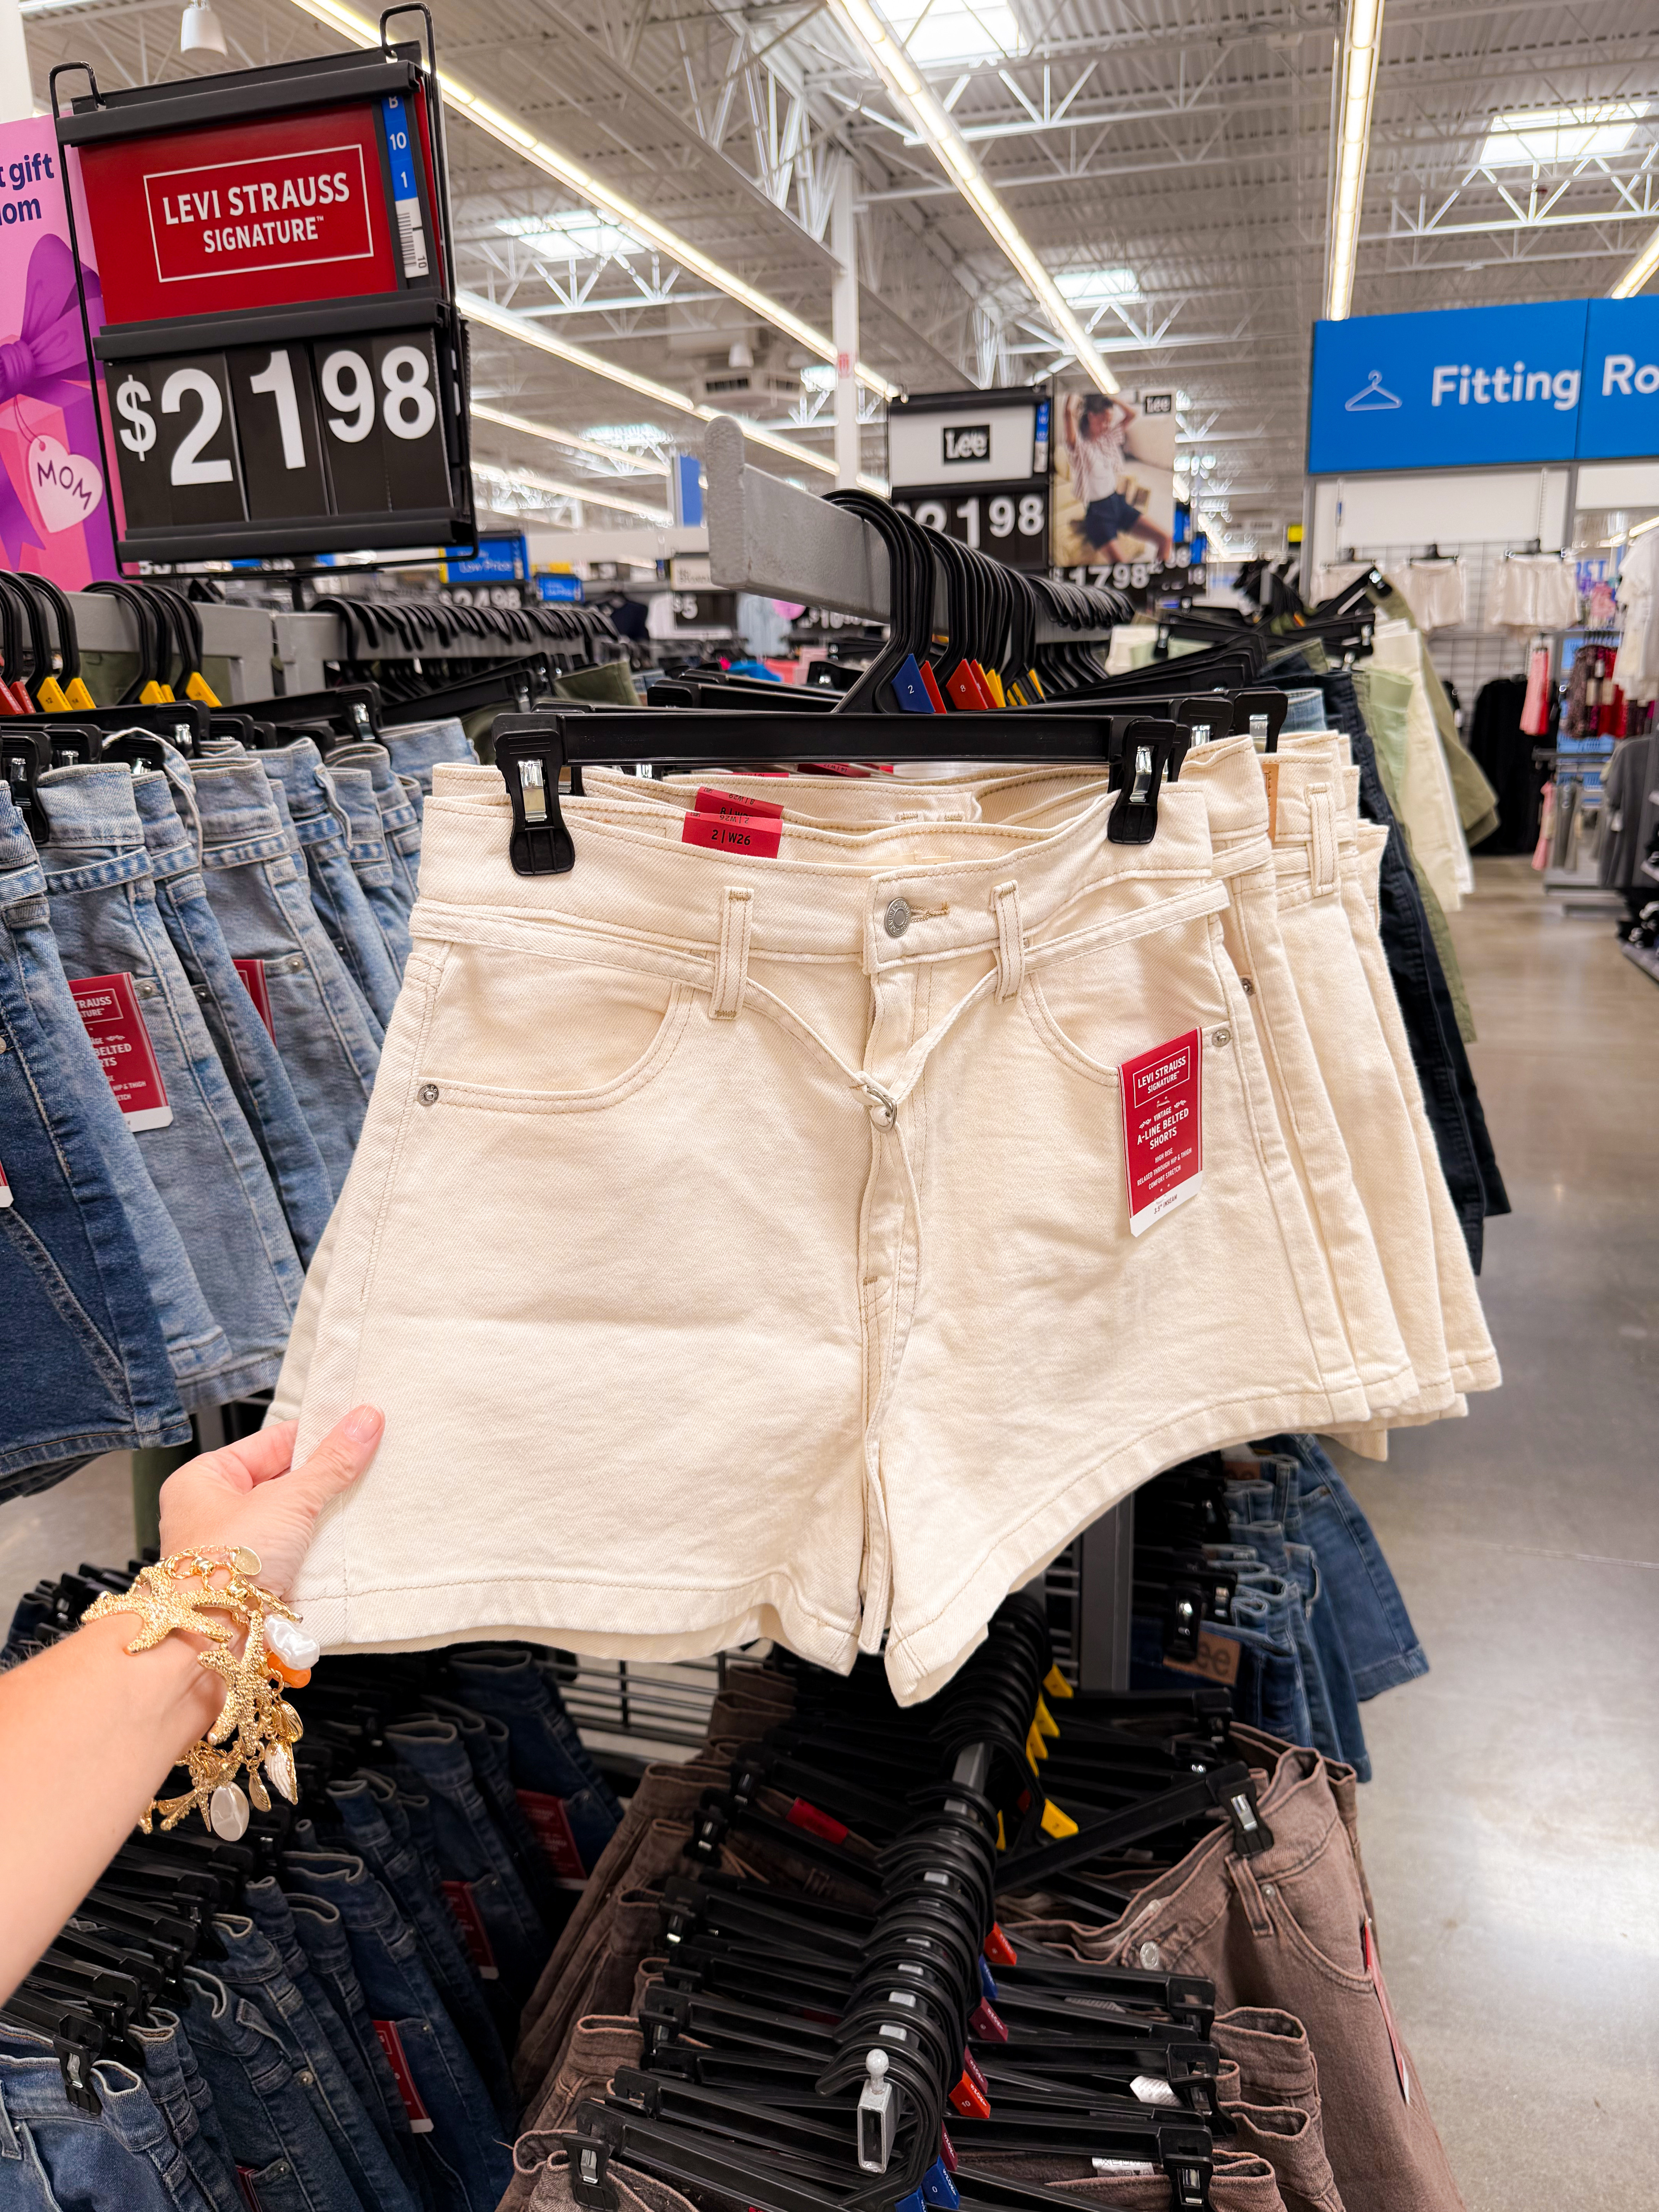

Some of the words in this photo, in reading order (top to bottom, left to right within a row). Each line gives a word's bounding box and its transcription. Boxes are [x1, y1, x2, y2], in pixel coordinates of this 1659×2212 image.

[390, 132, 407, 151] 10
[9, 153, 54, 191] gift
[401, 171, 408, 188] 1
[162, 189, 220, 225] LEVI
[229, 172, 349, 217] STRAUSS
[0, 198, 41, 225] om
[417, 255, 427, 269] 10
[1431, 360, 1581, 410] Fitting
[1602, 354, 1659, 396] Ro
[1146, 397, 1170, 413] Lee
[945, 430, 987, 459] Lee
[37, 460, 91, 510] MOM
[908, 685, 914, 694] 2
[75, 996, 112, 1009] TRAUSS
[94, 1043, 132, 1056] BELTED
[1137, 1072, 1154, 1089] LEVI
[1155, 1055, 1187, 1079] STRAUSS
[1153, 1106, 1172, 1122] VINTAGE
[1137, 1123, 1161, 1145] A-LINE
[1163, 1108, 1189, 1130] BELTED
[1150, 1127, 1177, 1150] SHORTS
[1137, 1172, 1153, 1187] RELAXED
[1153, 1161, 1171, 1177] THROUGH
[1181, 1147, 1192, 1158] THIGH
[1155, 1154, 1164, 1164] HIGH
[1164, 1147, 1173, 1158] RISE
[1148, 1174, 1165, 1190] COMFORT
[1165, 1164, 1182, 1180] STRETCH
[1163, 1194, 1178, 1209] INSEAM
